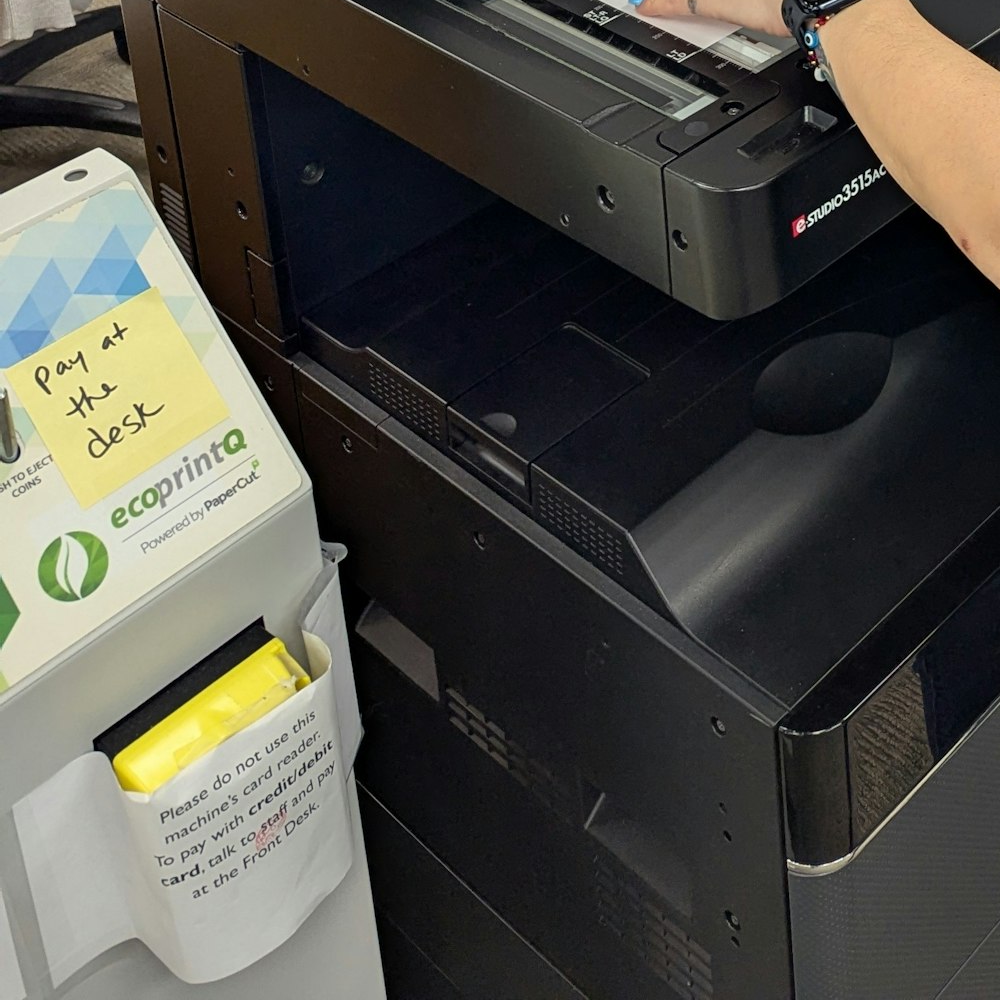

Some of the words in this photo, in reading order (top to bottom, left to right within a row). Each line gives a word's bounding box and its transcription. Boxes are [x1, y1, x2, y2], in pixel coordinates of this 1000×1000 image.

[101, 321, 129, 351] at
[66, 381, 118, 419] the
[87, 402, 165, 459] desk
[11, 472, 25, 483] TO
[26, 454, 53, 475] EJECT
[12, 476, 41, 497] COINS
[111, 427, 248, 529] ecoprintQ
[140, 516, 191, 555] Powered
[190, 506, 206, 528] by
[204, 470, 261, 512] PaperCut
[155, 855, 174, 868] To
[181, 839, 207, 866] pay
[211, 812, 245, 840] with
[248, 740, 334, 816] credit/debit
[159, 788, 209, 824] Please
[212, 772, 232, 791] do
[235, 751, 262, 775] not
[265, 732, 289, 754] use
[291, 710, 317, 735] this
[164, 796, 239, 845] machine's
[242, 768, 275, 795] card
[277, 732, 322, 772] reader.
[161, 864, 206, 888] card,
[209, 845, 238, 868] talk
[240, 831, 256, 846] to
[260, 802, 289, 832] staff
[291, 782, 314, 807] and
[317, 759, 336, 788] pay
[191, 885, 209, 899] at
[213, 866, 239, 890] the
[242, 836, 283, 870] Front
[284, 803, 320, 837] Desk.
